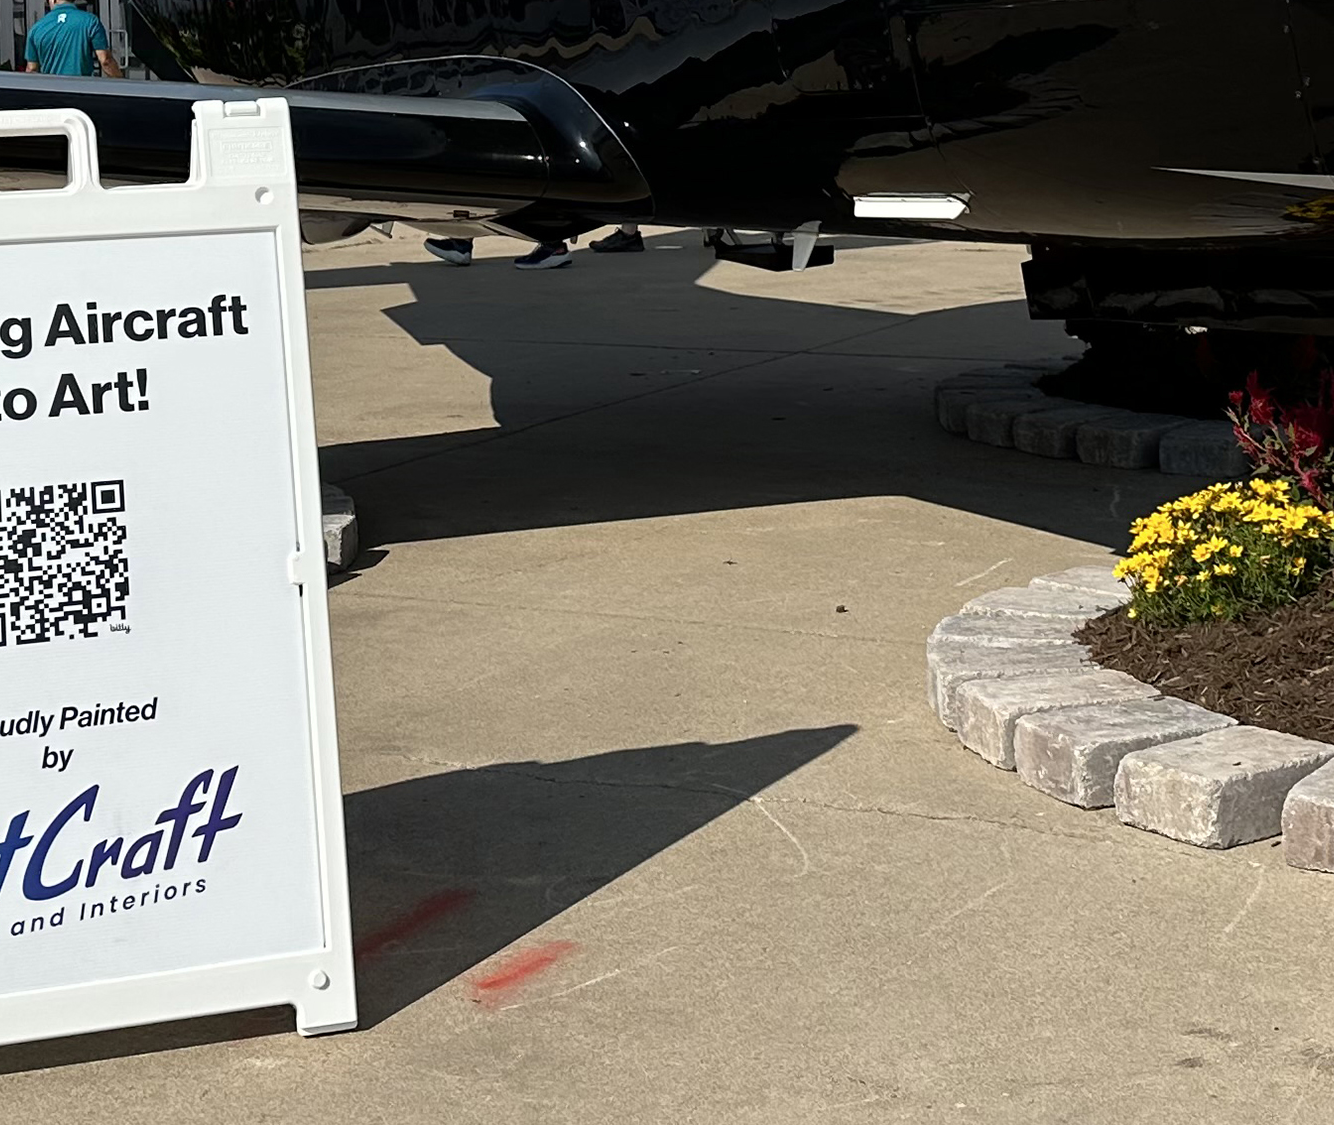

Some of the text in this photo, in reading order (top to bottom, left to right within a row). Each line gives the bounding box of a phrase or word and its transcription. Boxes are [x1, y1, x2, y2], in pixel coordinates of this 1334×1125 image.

[44, 294, 249, 347] Aircraft
[48, 368, 150, 417] Art!
[59, 697, 159, 730] Painted
[41, 746, 74, 772] by
[10, 907, 65, 937] and
[79, 878, 207, 921] Interiors
